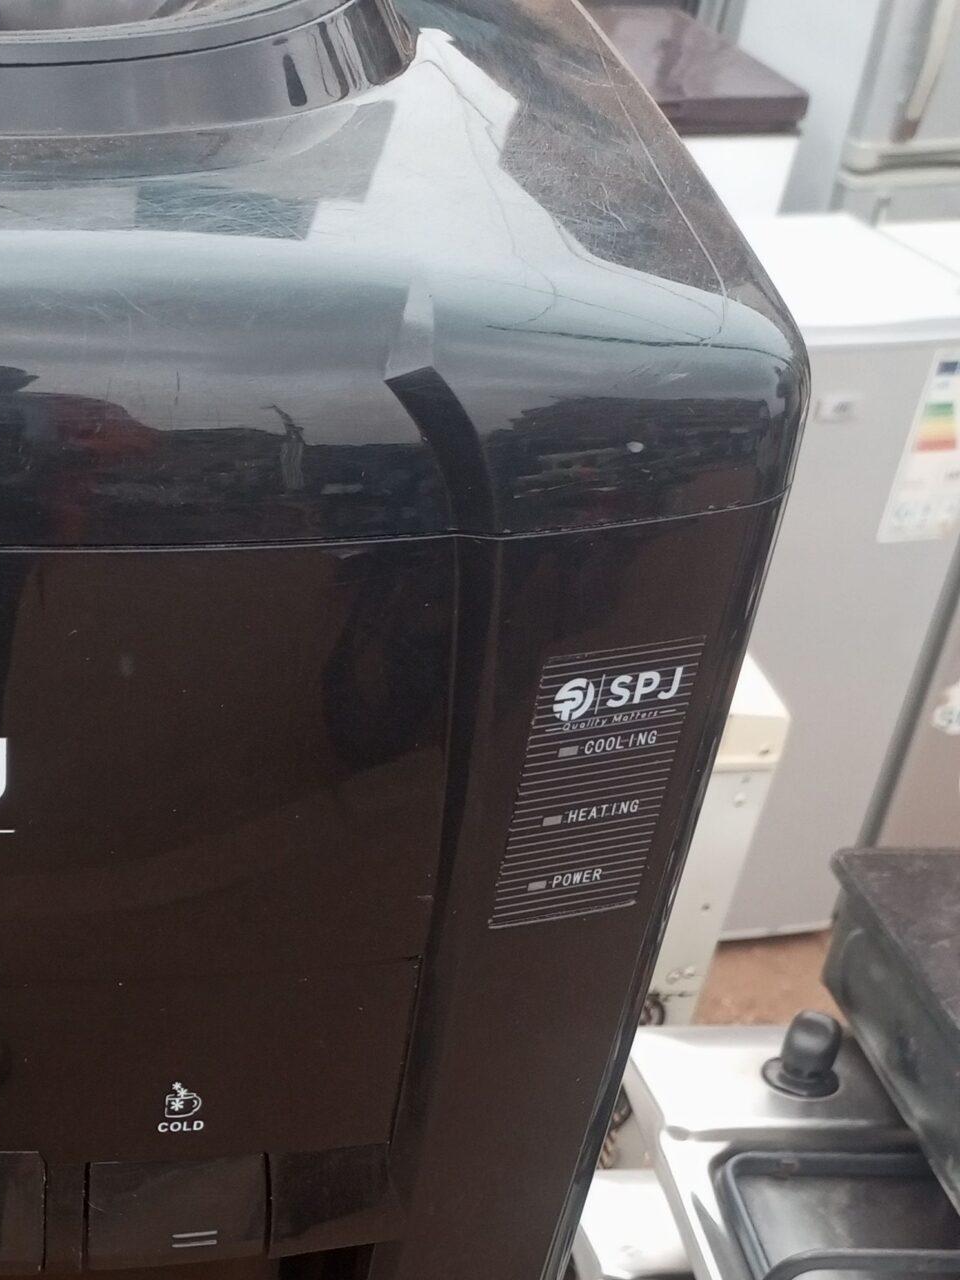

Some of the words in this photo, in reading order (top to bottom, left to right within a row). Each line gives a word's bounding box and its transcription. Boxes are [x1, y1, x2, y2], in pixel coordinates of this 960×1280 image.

[606, 666, 684, 708] SPJ
[562, 718, 608, 732] Quality
[613, 710, 659, 723] Matters
[584, 730, 658, 755] COOLING
[567, 799, 640, 823] HEATING
[552, 868, 603, 888] POWER
[158, 1120, 205, 1133] COLD
